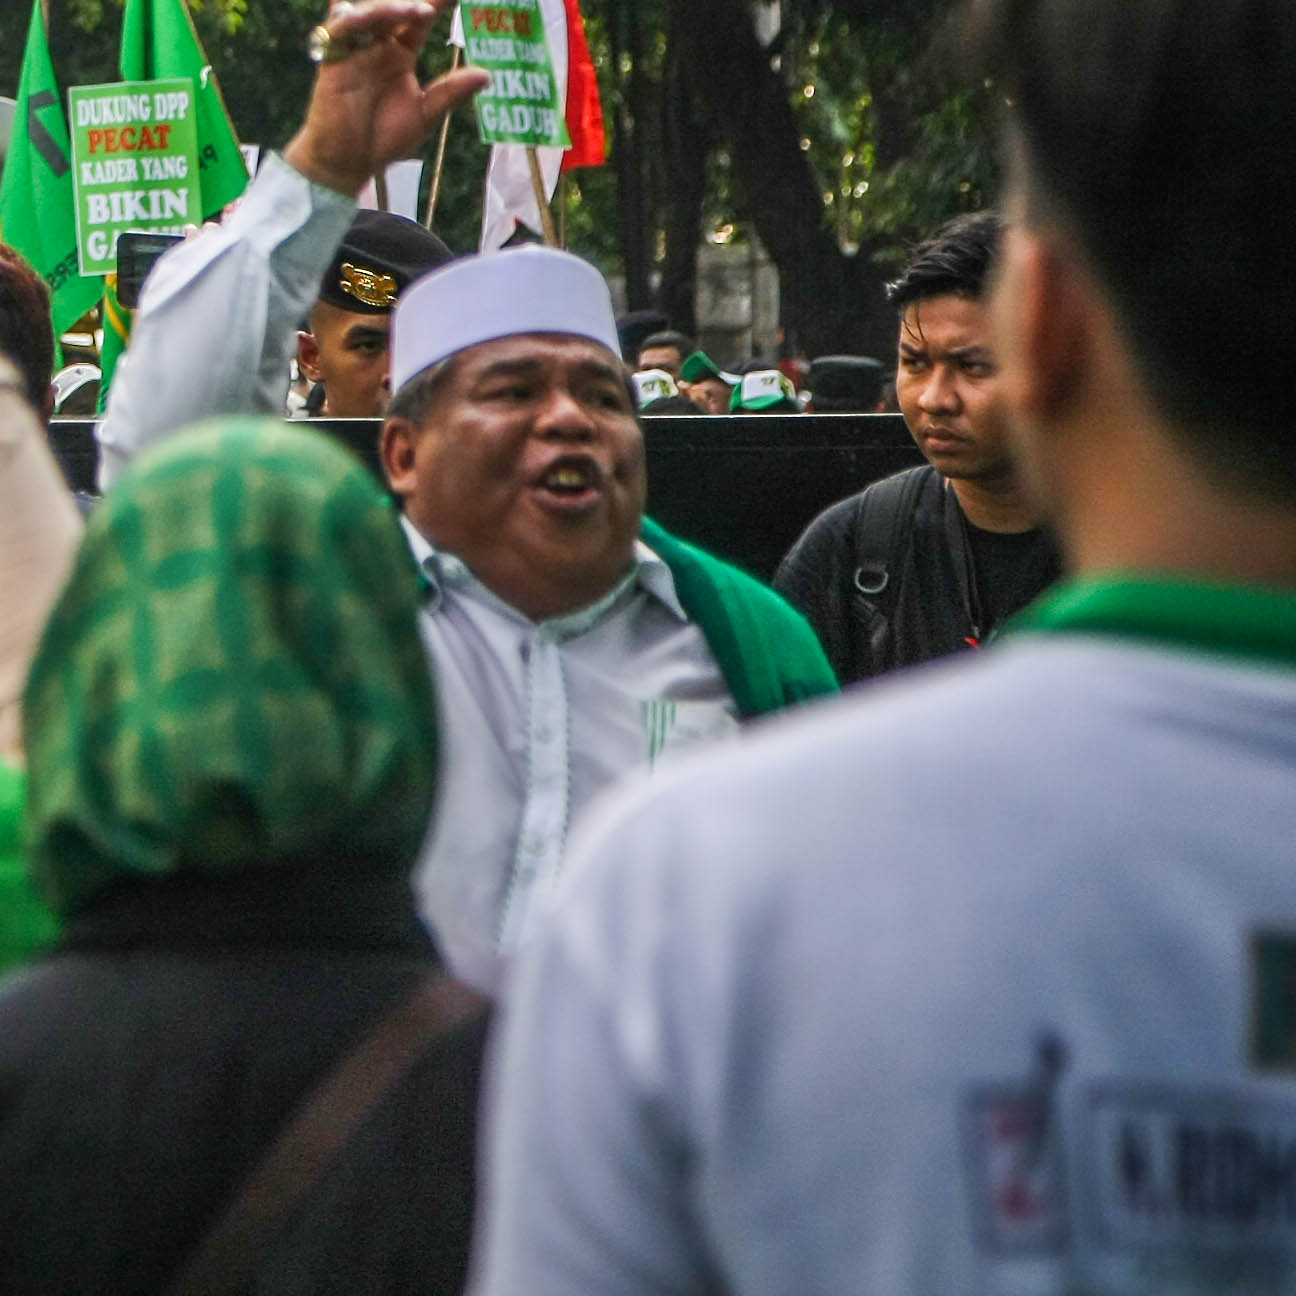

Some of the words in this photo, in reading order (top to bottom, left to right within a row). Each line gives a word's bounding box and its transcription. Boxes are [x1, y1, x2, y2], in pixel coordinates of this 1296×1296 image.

[76, 93, 152, 127] DUKUNG
[154, 91, 189, 121] DPP
[87, 124, 172, 155] PECAT
[80, 157, 139, 187] KADER
[141, 155, 189, 181] YANG
[85, 188, 189, 225] BIKIN
